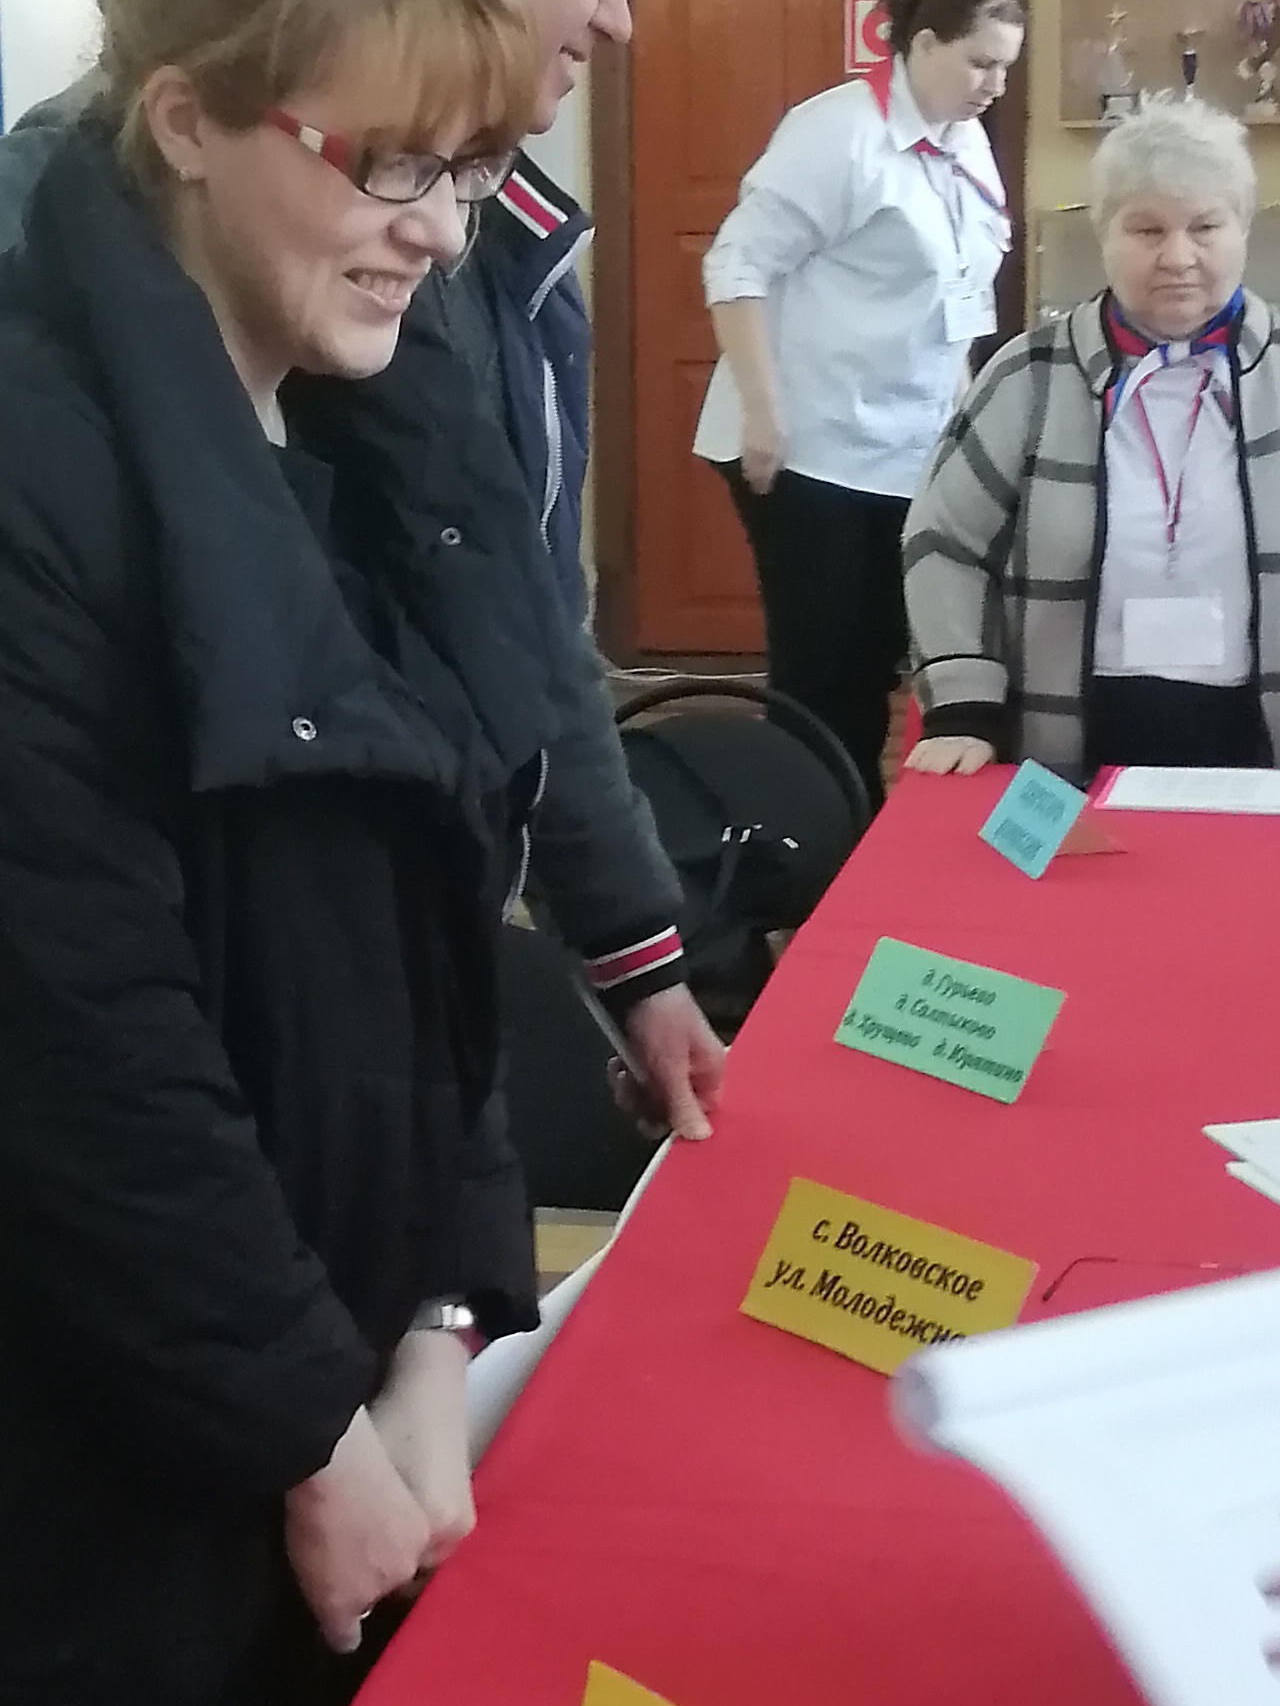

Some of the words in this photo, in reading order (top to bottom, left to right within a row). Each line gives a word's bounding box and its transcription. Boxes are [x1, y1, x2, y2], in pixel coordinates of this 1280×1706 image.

[764, 1259, 805, 1291] ул.
[812, 1219, 828, 1243] с.
[835, 1221, 986, 1302] Волковское
